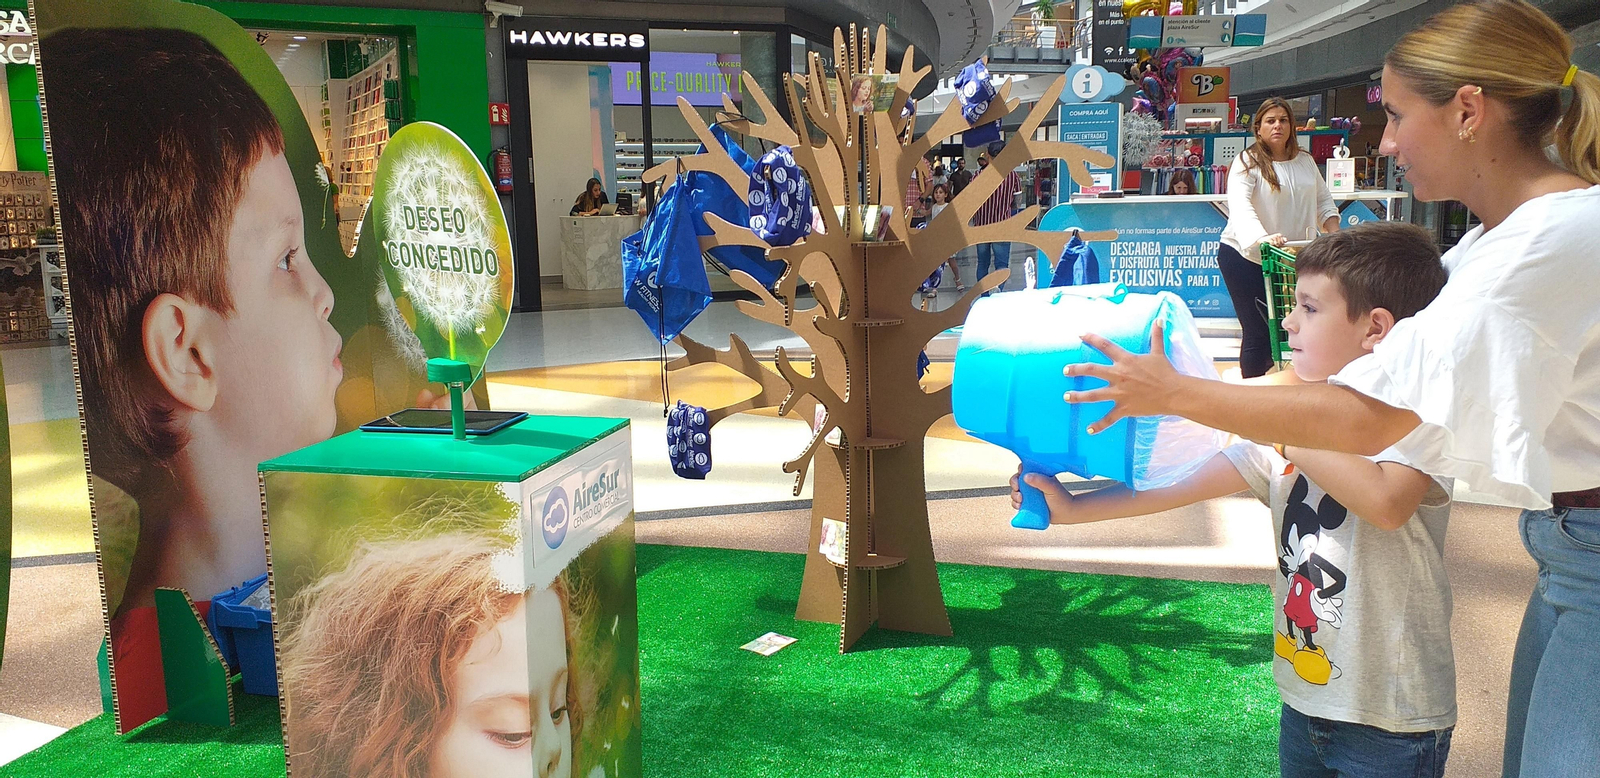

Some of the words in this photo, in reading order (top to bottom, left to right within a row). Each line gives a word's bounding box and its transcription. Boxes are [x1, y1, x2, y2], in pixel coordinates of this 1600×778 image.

[509, 29, 646, 48] HAWKERS
[1094, 108, 1109, 116] AQUÍ
[1066, 133, 1079, 141] SACA
[1081, 132, 1106, 141] ENTRADAS
[403, 205, 466, 234] DESEO
[1134, 227, 1155, 235] formas
[1156, 227, 1171, 236] parte
[1181, 226, 1204, 235] AireSur
[1204, 226, 1221, 234] Club?
[1110, 241, 1161, 256] DESCARGA
[1165, 245, 1197, 256] NUESTRA
[1200, 241, 1220, 256] APP
[387, 240, 499, 277] CONCEDIDO
[1110, 257, 1117, 269] Y
[1119, 257, 1160, 269] DISFRUTA
[1163, 256, 1175, 269] DE
[1178, 256, 1220, 269] VENTAJAS
[1109, 269, 1183, 287] EXCLUSIVAS
[1187, 275, 1209, 287] PARA
[1212, 275, 1220, 287] TI
[573, 468, 620, 515] AireSur
[573, 505, 593, 529] CENTRO
